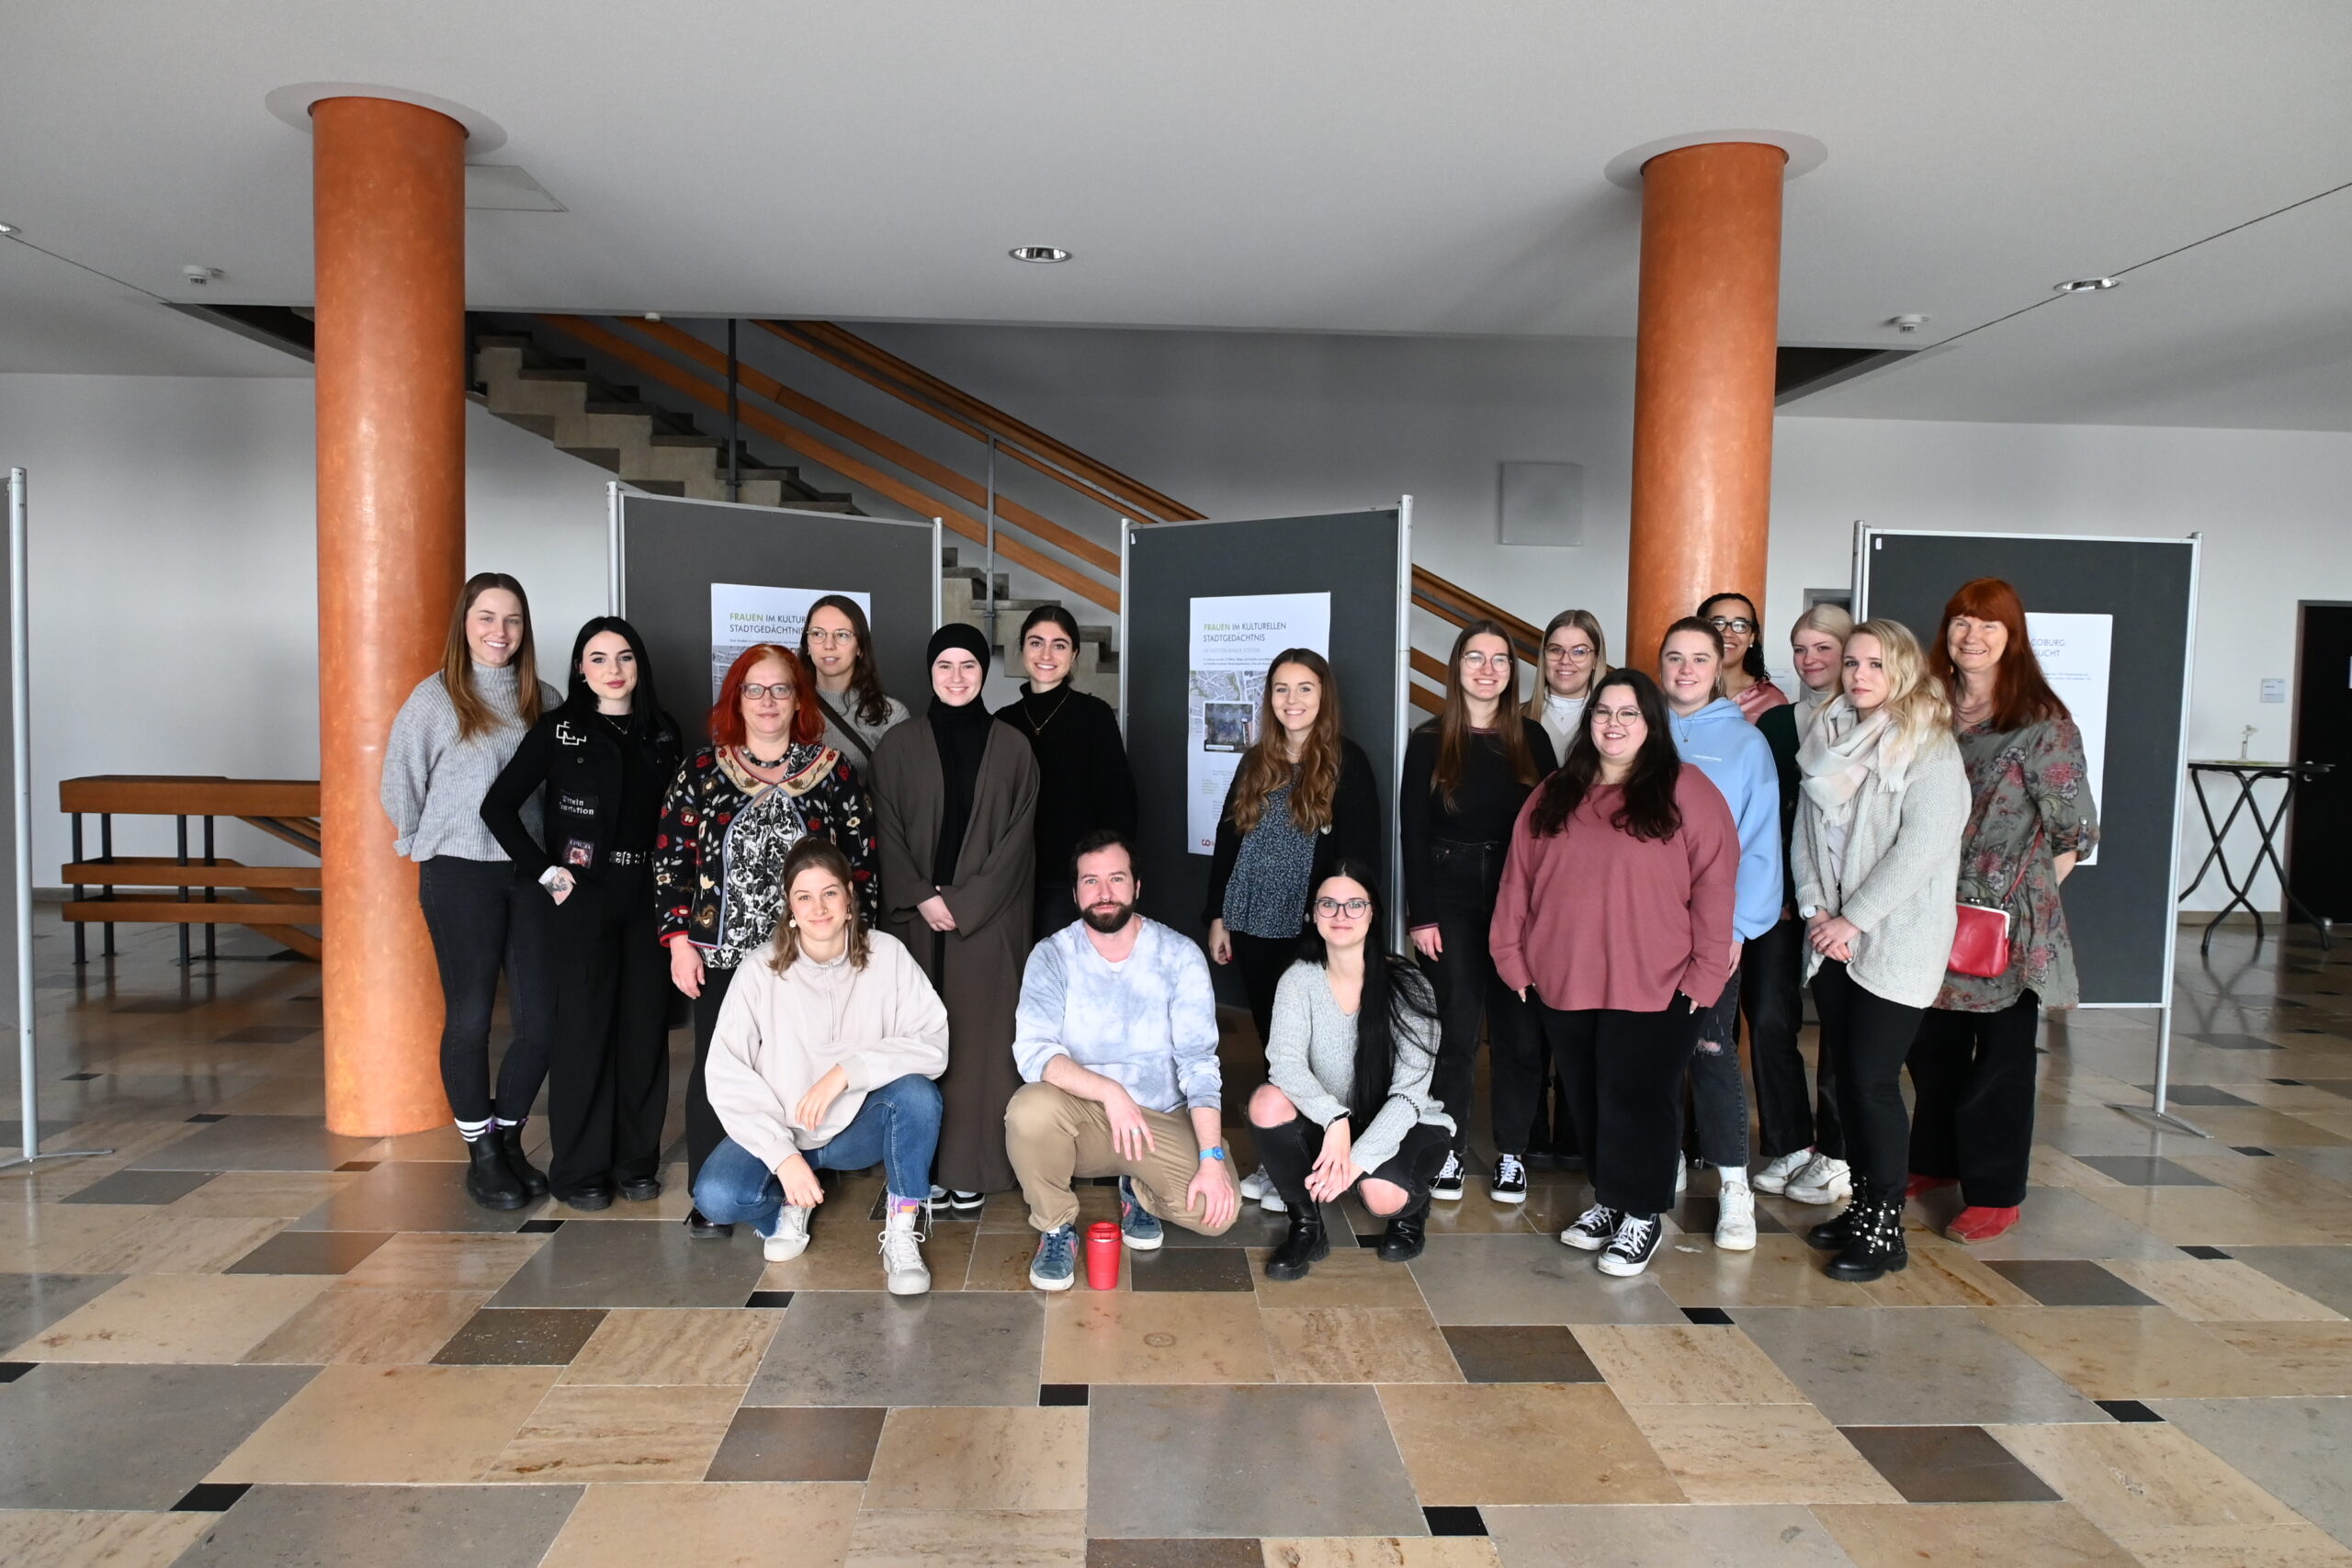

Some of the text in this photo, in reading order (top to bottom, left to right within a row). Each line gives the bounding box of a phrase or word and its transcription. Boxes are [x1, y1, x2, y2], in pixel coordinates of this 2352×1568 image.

[729, 613, 763, 622] FRAUEN
[765, 615, 775, 623] IM
[1204, 622, 1286, 631] FRAUEN IM KULTURELLEN
[1203, 632, 1265, 642] STADTGEDÄCHTNIS
[2030, 638, 2065, 647] COBURG
